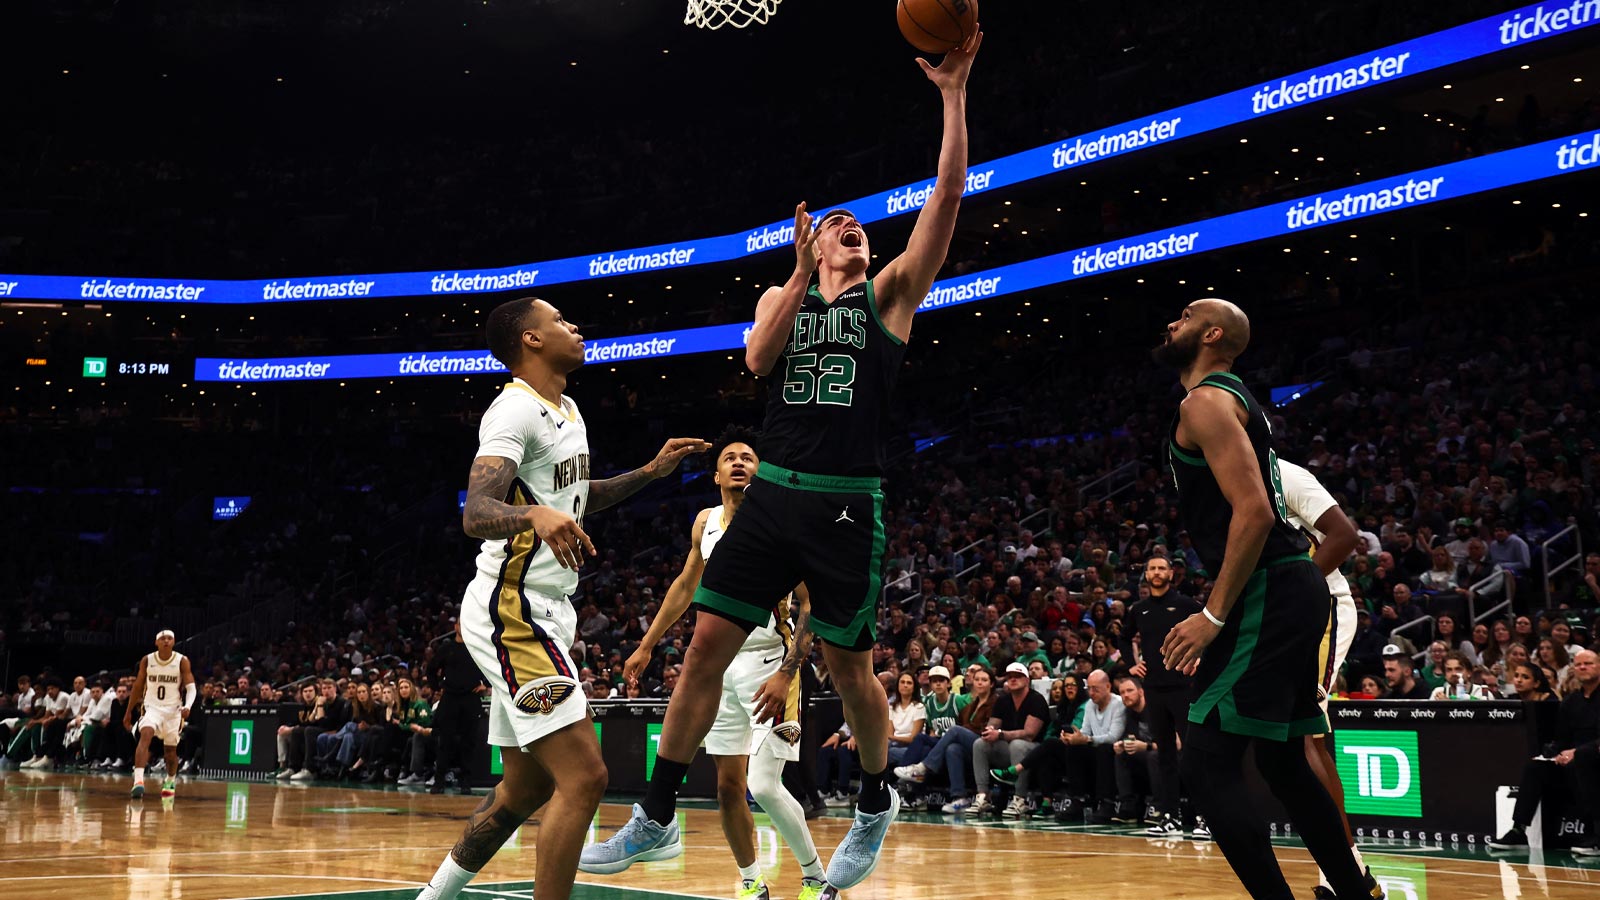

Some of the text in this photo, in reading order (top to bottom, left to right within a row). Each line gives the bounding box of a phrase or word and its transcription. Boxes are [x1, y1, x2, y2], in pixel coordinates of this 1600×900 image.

[1499, 0, 1600, 45] ticketm
[1252, 52, 1410, 114] ticketmaster
[1052, 117, 1181, 168] ticketmaster
[886, 169, 995, 215] ticketter
[1286, 176, 1444, 229] ticketmaster
[588, 247, 695, 276] ticketmaster
[1072, 231, 1199, 275] ticketmaster
[80, 279, 375, 301] ticketmaster ticketmaster
[431, 269, 539, 292] ticketmaster
[919, 276, 1001, 309] etmaster
[784, 307, 867, 355] ELTICS
[584, 337, 676, 362] cketmaster
[118, 362, 146, 374] 8:13
[149, 363, 169, 375] PM
[218, 360, 331, 379] ticketmaster
[783, 353, 857, 407] 52
[553, 456, 578, 493] NEW
[157, 685, 166, 701] 0
[1337, 707, 1363, 718] xfinity
[1373, 708, 1399, 719] xfinity
[1410, 708, 1437, 719] xfinity
[1448, 708, 1476, 719] xfinity
[1487, 708, 1516, 720] xfinity
[232, 727, 251, 756] TD
[1343, 745, 1411, 798] TD
